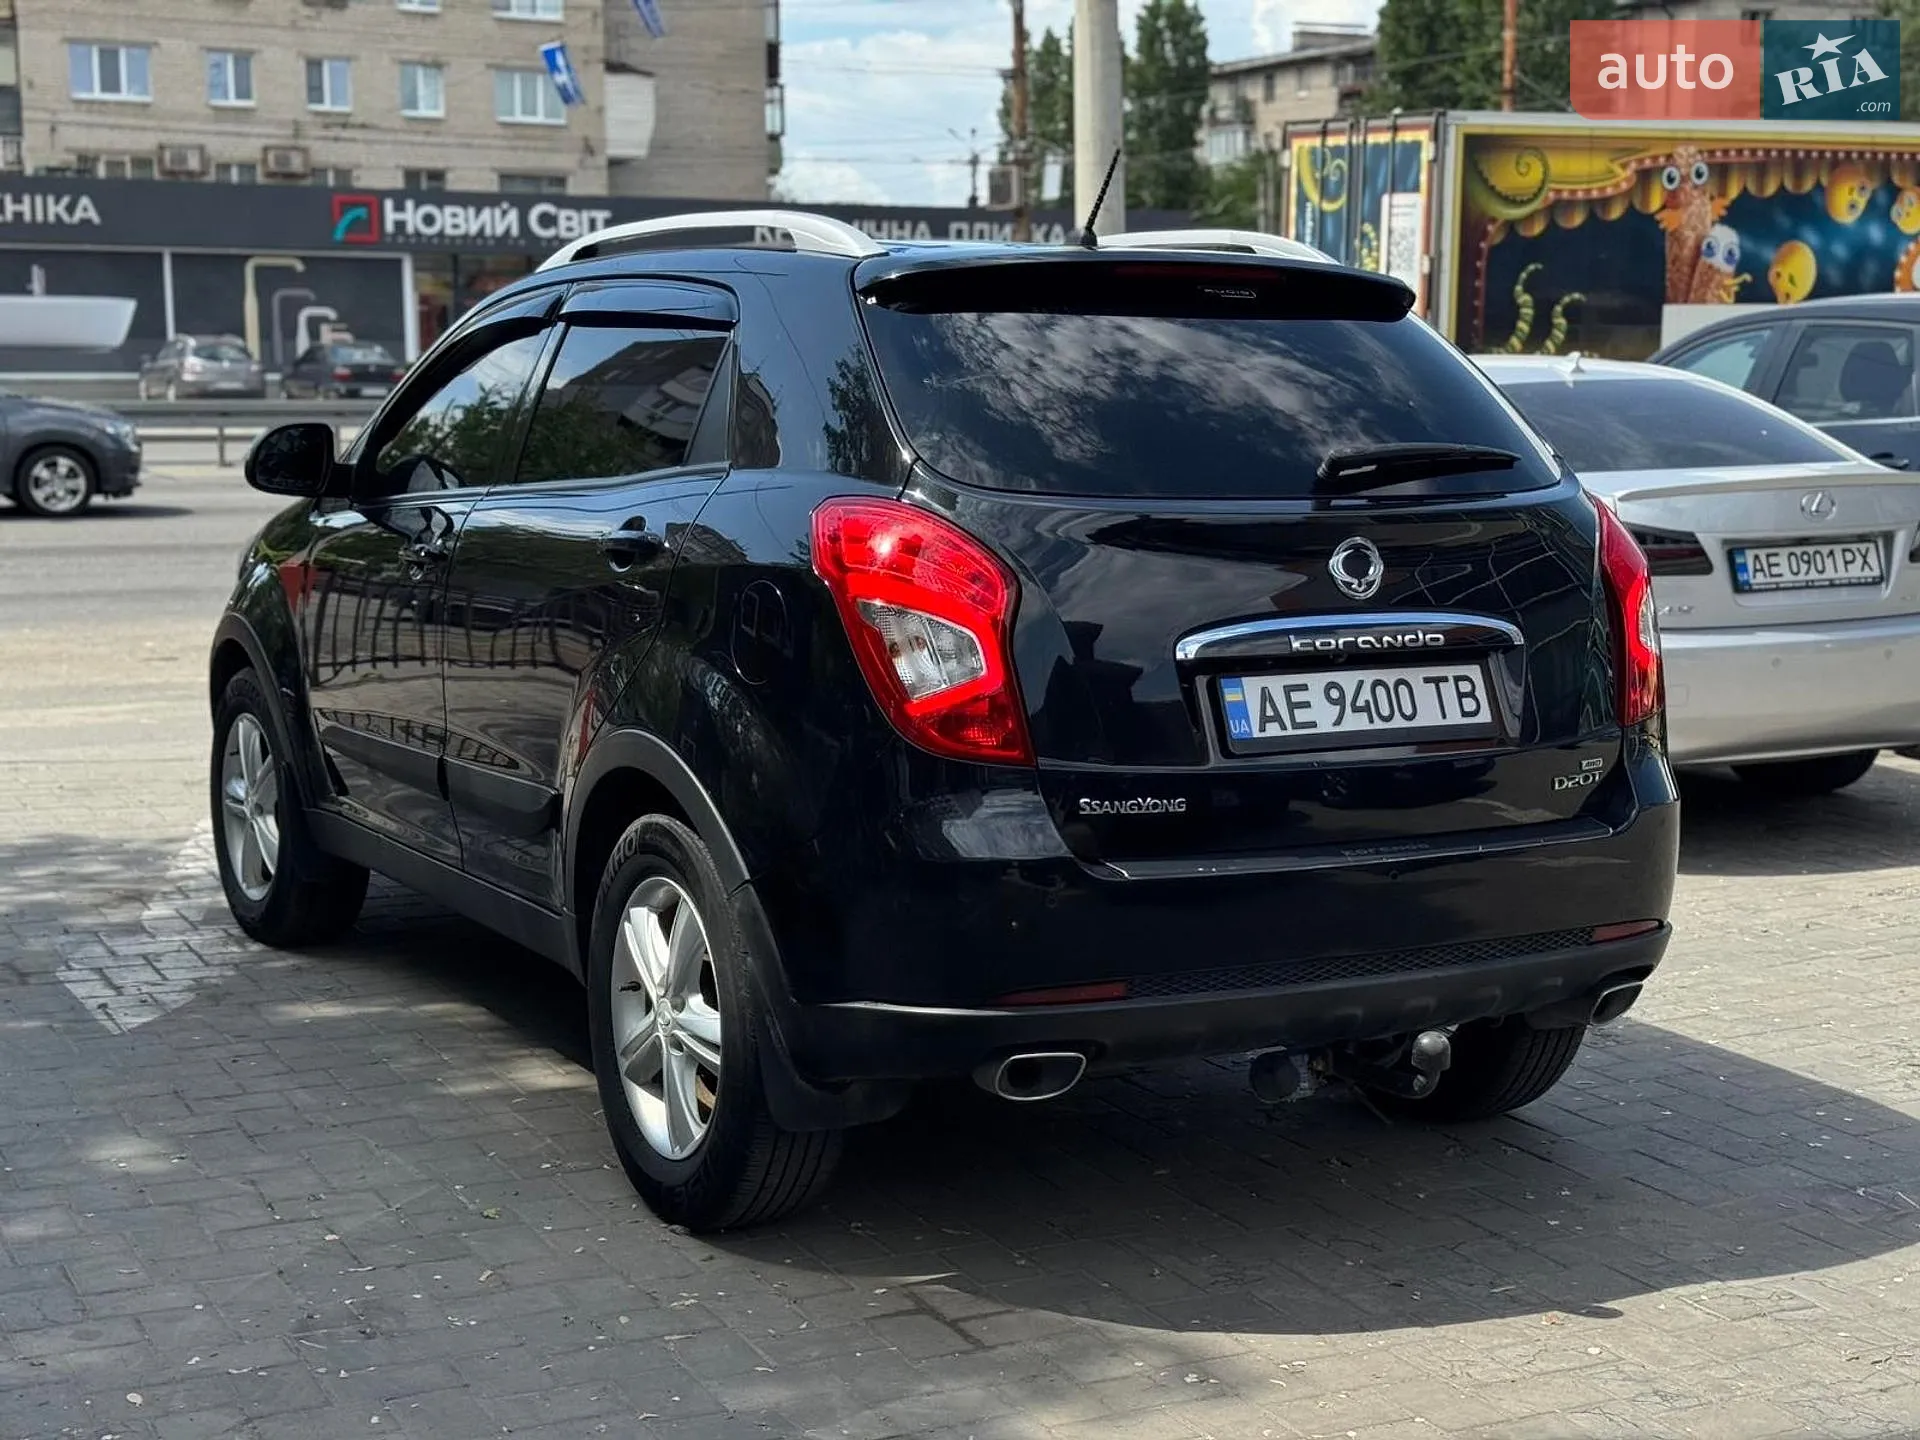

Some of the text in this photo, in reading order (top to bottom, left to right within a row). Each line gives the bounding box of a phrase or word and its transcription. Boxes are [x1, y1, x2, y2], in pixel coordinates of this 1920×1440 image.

[0, 192, 102, 226] НІКА
[1752, 552, 1784, 580] AE
[1787, 548, 1839, 577] 0901
[1842, 547, 1874, 574] PX
[1258, 674, 1482, 733] AE 9400 TB
[1229, 719, 1250, 734] UA
